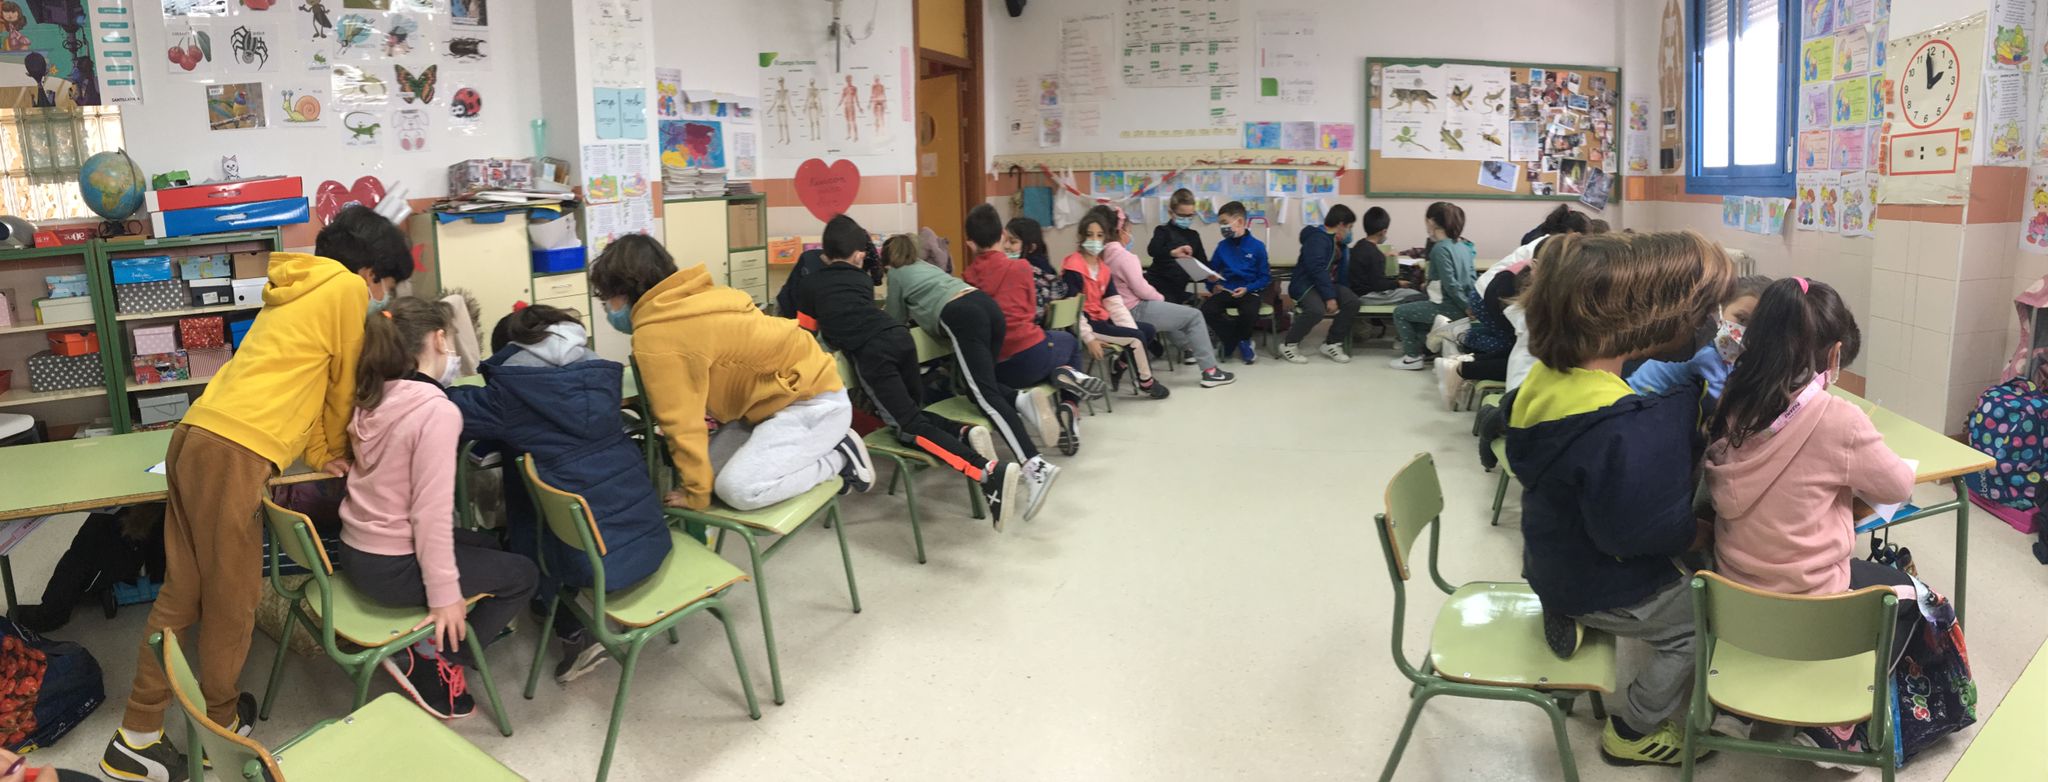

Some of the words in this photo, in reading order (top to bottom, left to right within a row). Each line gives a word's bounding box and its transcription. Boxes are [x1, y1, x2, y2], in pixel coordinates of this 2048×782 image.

[1927, 47, 1936, 56] 12
[1942, 50, 1946, 58] 1
[1917, 56, 1923, 64] 11
[1948, 60, 1953, 70] 2
[1908, 68, 1915, 77] 10
[1950, 76, 1955, 86] 3
[1904, 85, 1909, 94] 9
[1945, 94, 1950, 103] 4
[1907, 101, 1912, 110] 8
[1913, 111, 1918, 120] 7
[1936, 107, 1941, 116] 5
[1923, 114, 1929, 123] 6
